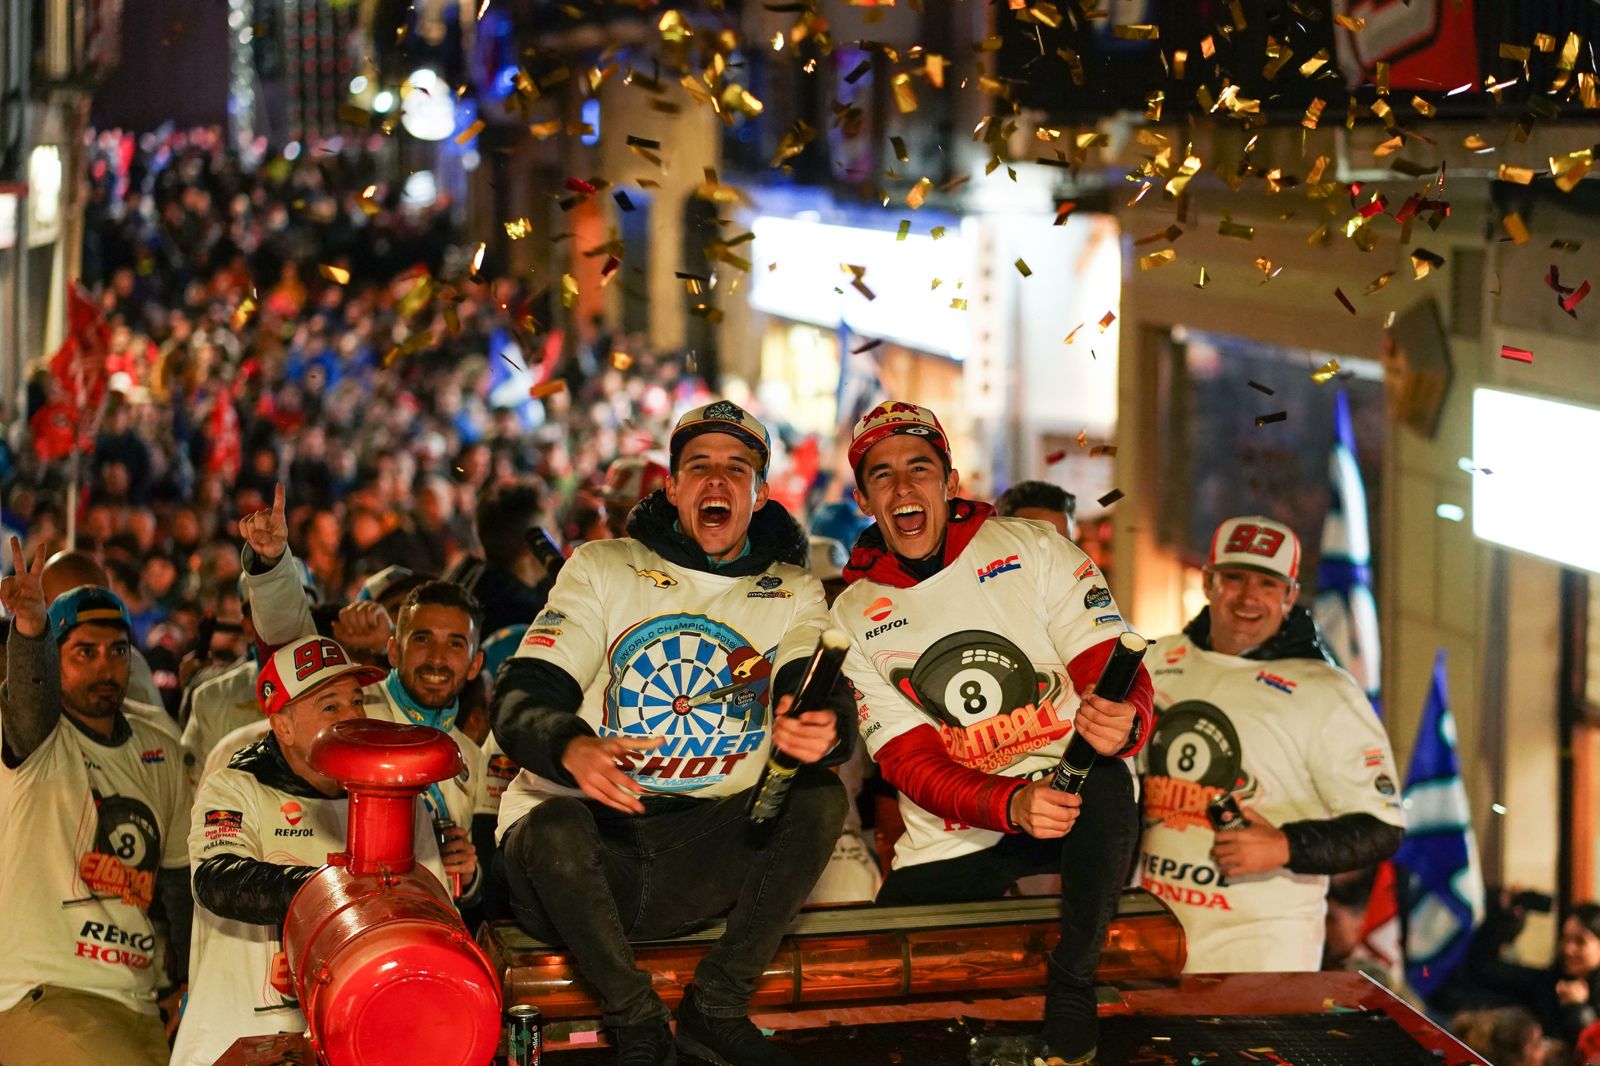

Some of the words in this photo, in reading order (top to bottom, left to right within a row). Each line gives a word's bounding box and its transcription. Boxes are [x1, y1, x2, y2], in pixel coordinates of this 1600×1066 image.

[1224, 525, 1285, 558] 93
[977, 555, 1021, 583] HRC
[620, 632, 655, 660] WORLD
[657, 623, 712, 635] CHAMPION
[714, 632, 737, 649] 2019
[865, 618, 909, 640] REPSOL
[294, 639, 347, 681] 93
[960, 680, 987, 714] 8
[986, 736, 1051, 762] CHAMPION
[1177, 743, 1197, 772] 8
[615, 752, 748, 778] SHOT
[981, 755, 1013, 774] 2019
[117, 833, 136, 859] 8
[275, 828, 314, 837] REPSOL
